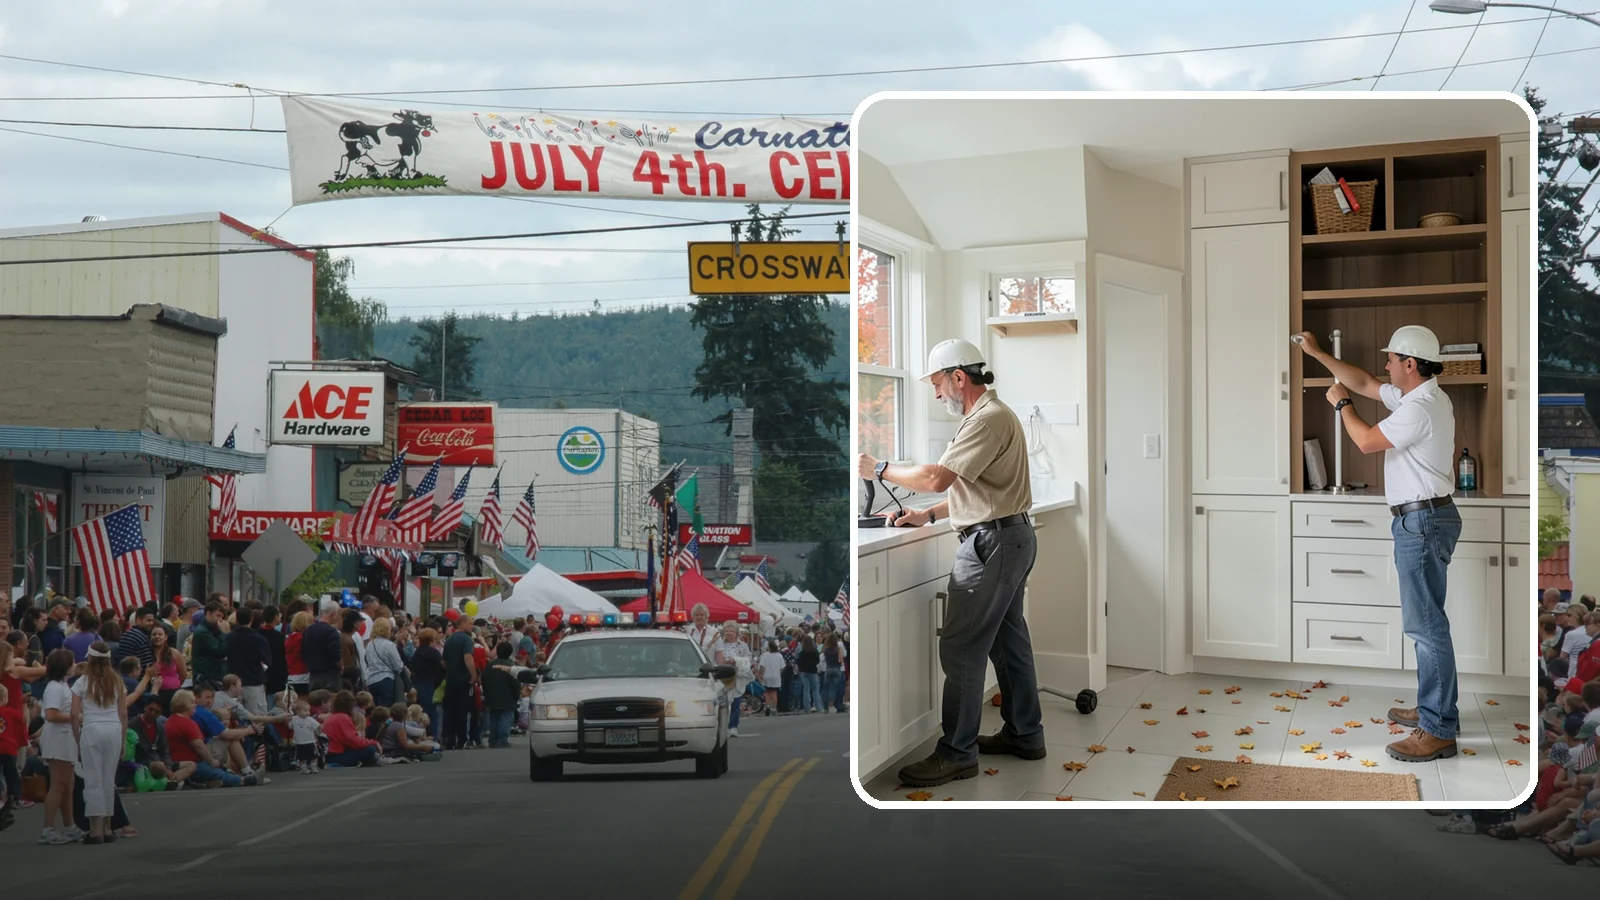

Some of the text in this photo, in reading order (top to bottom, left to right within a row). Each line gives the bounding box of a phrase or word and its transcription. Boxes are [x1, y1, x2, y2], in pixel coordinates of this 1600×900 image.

[481, 141, 605, 193] JULY
[632, 150, 747, 198] 4th.
[697, 254, 850, 280] CROSSWA
[283, 380, 374, 420] ACE
[406, 409, 453, 422] CEDAR
[283, 421, 371, 436] Hardware
[416, 428, 477, 447] Coca-Cola
[95, 485, 124, 495] Vincent
[126, 486, 136, 495] de
[138, 486, 155, 496] Paul
[688, 526, 742, 535] CRNATION
[699, 535, 731, 543] GLASS
